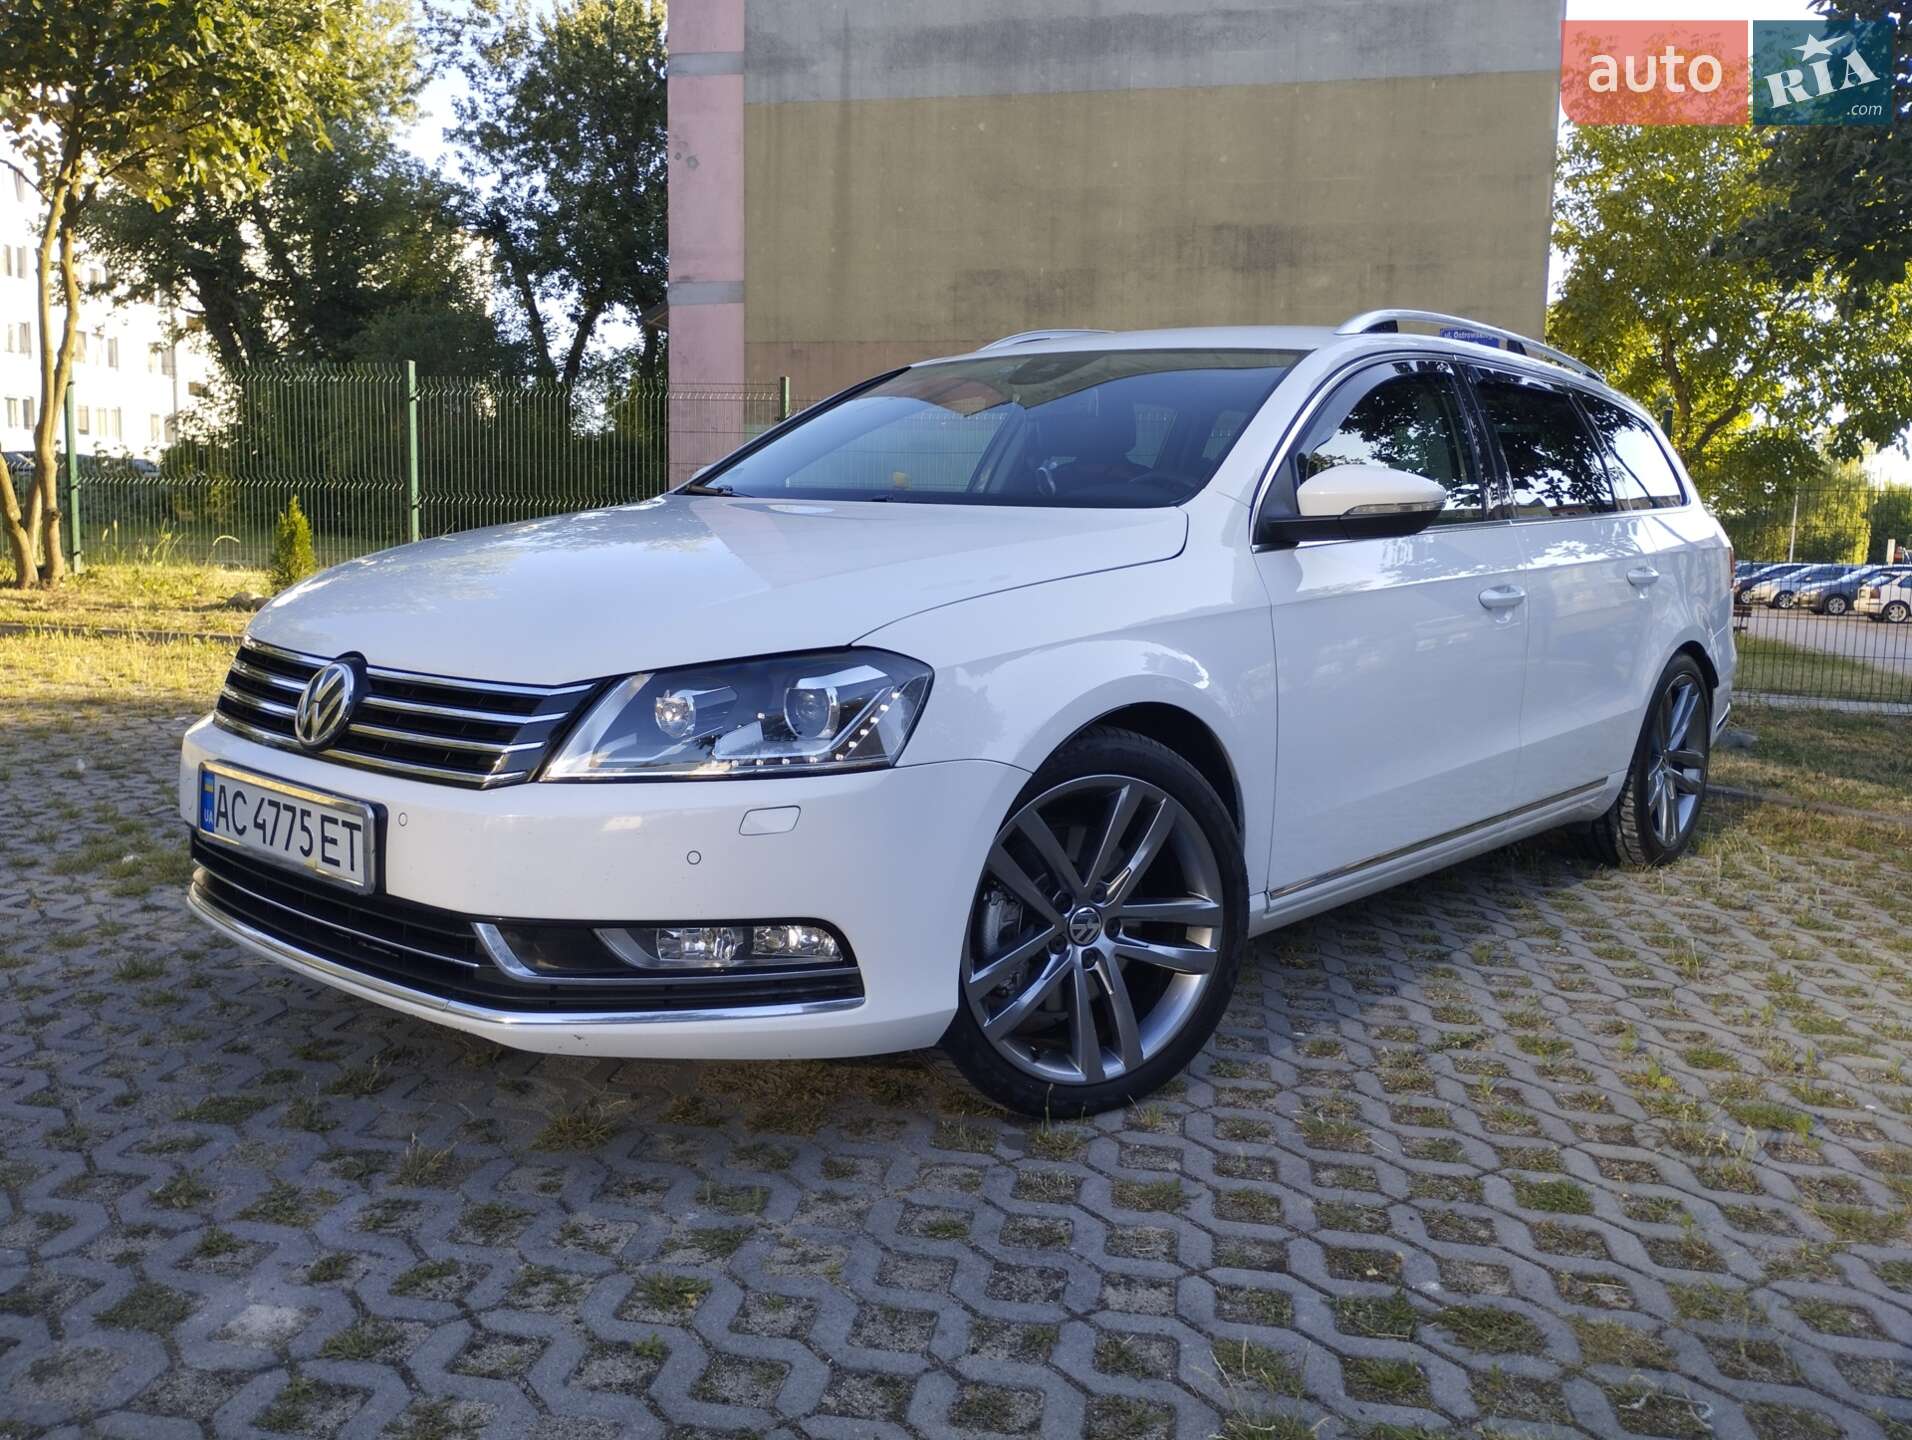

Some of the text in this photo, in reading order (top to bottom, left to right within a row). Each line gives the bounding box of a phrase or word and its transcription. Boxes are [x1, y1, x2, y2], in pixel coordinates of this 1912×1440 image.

[296, 663, 354, 745] VW
[204, 807, 214, 825] UA
[216, 784, 362, 872] AC 4775 ET
